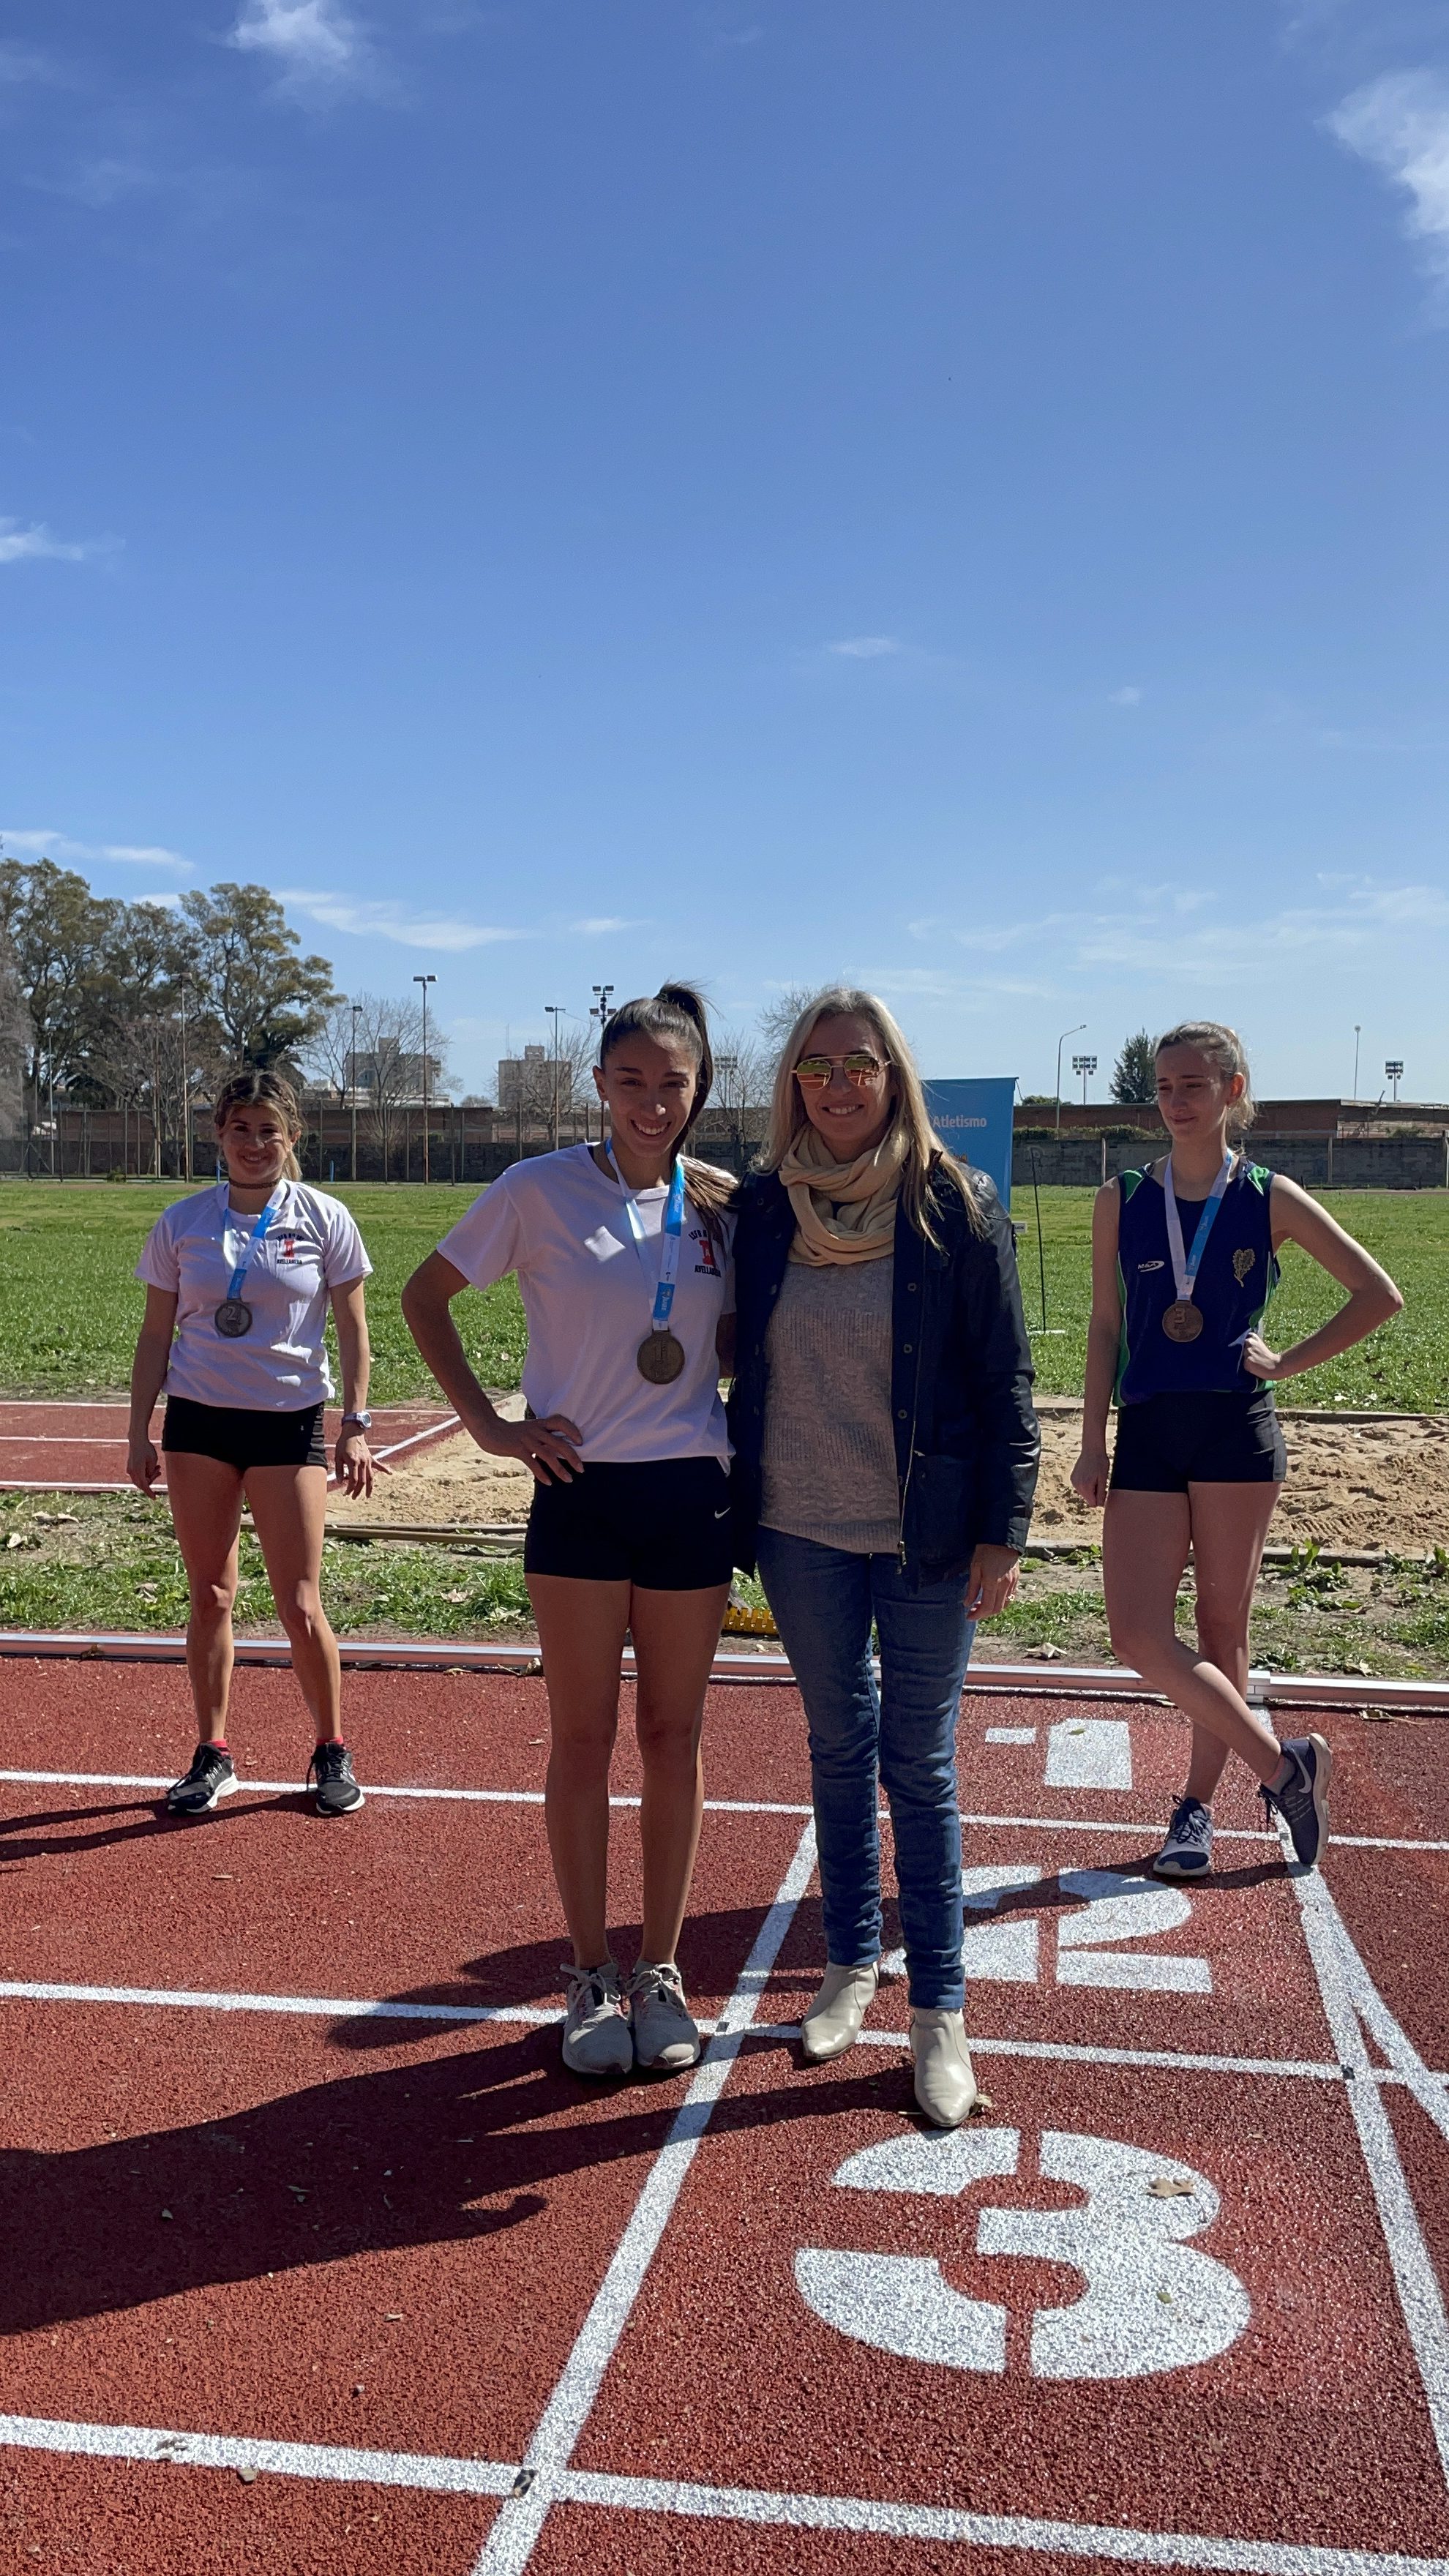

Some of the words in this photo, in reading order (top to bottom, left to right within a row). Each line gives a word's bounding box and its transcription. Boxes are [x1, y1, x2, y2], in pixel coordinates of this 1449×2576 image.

[933, 1115, 987, 1128] Atletismo
[227, 1306, 236, 1321] 2
[1174, 1307, 1186, 1324] 3
[794, 2127, 1251, 2380] 3
